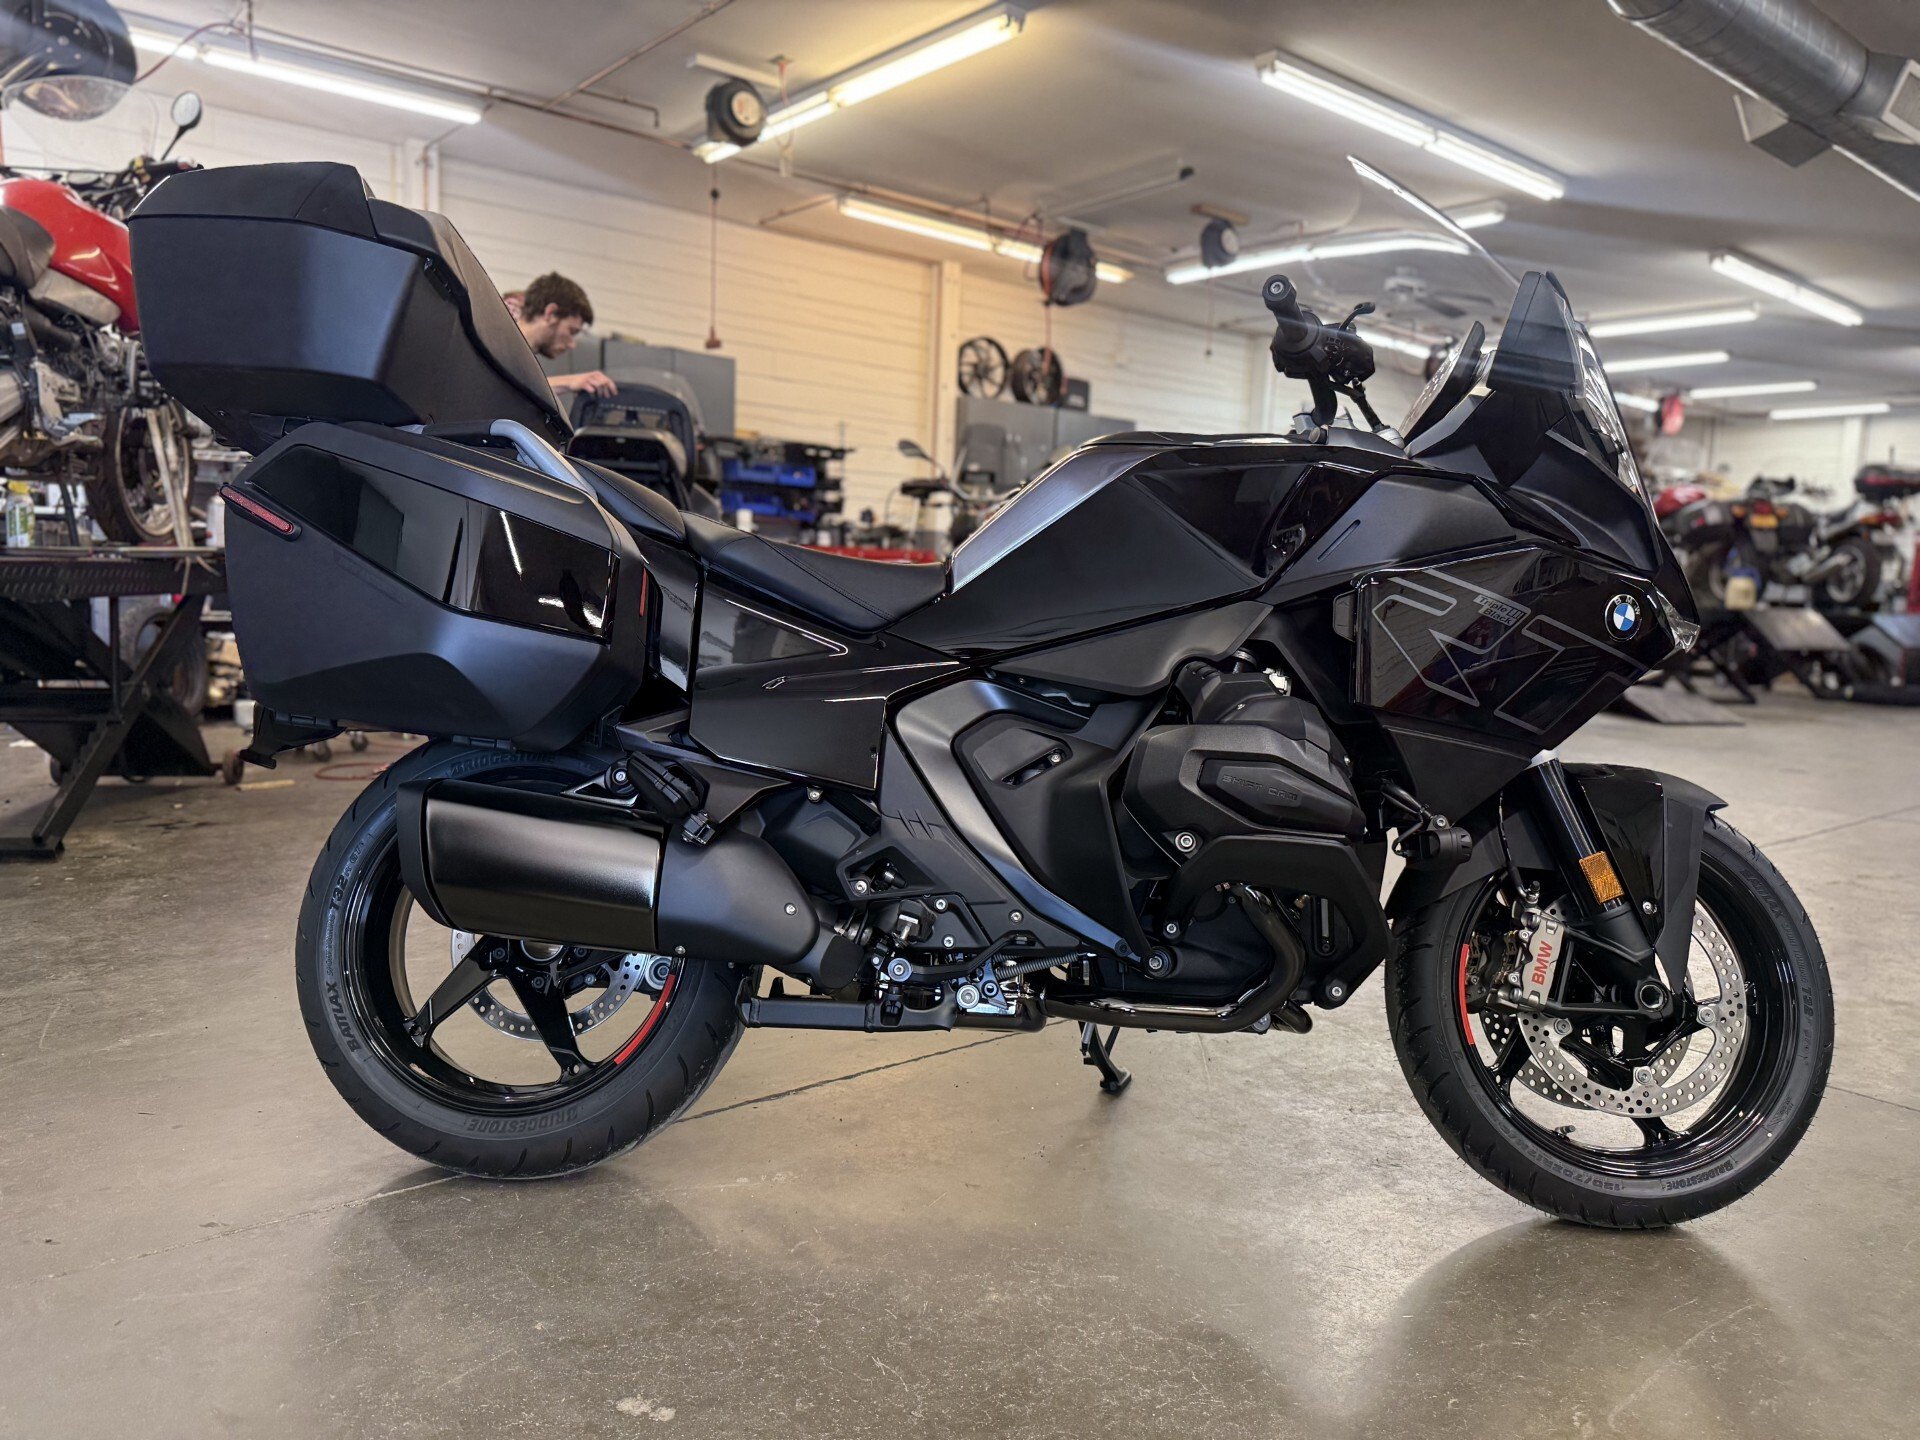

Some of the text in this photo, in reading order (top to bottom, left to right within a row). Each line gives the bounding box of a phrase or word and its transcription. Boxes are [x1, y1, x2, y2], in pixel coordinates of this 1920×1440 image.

[1479, 596, 1508, 613] Triple
[1483, 607, 1512, 625] Black
[1222, 774, 1263, 791] SHIFT
[1531, 940, 1553, 986] BMW
[326, 981, 362, 1053] BATTLAX
[466, 1108, 580, 1133] BRIDGESTONE
[1666, 1159, 1734, 1191] BRIDGESTONE
